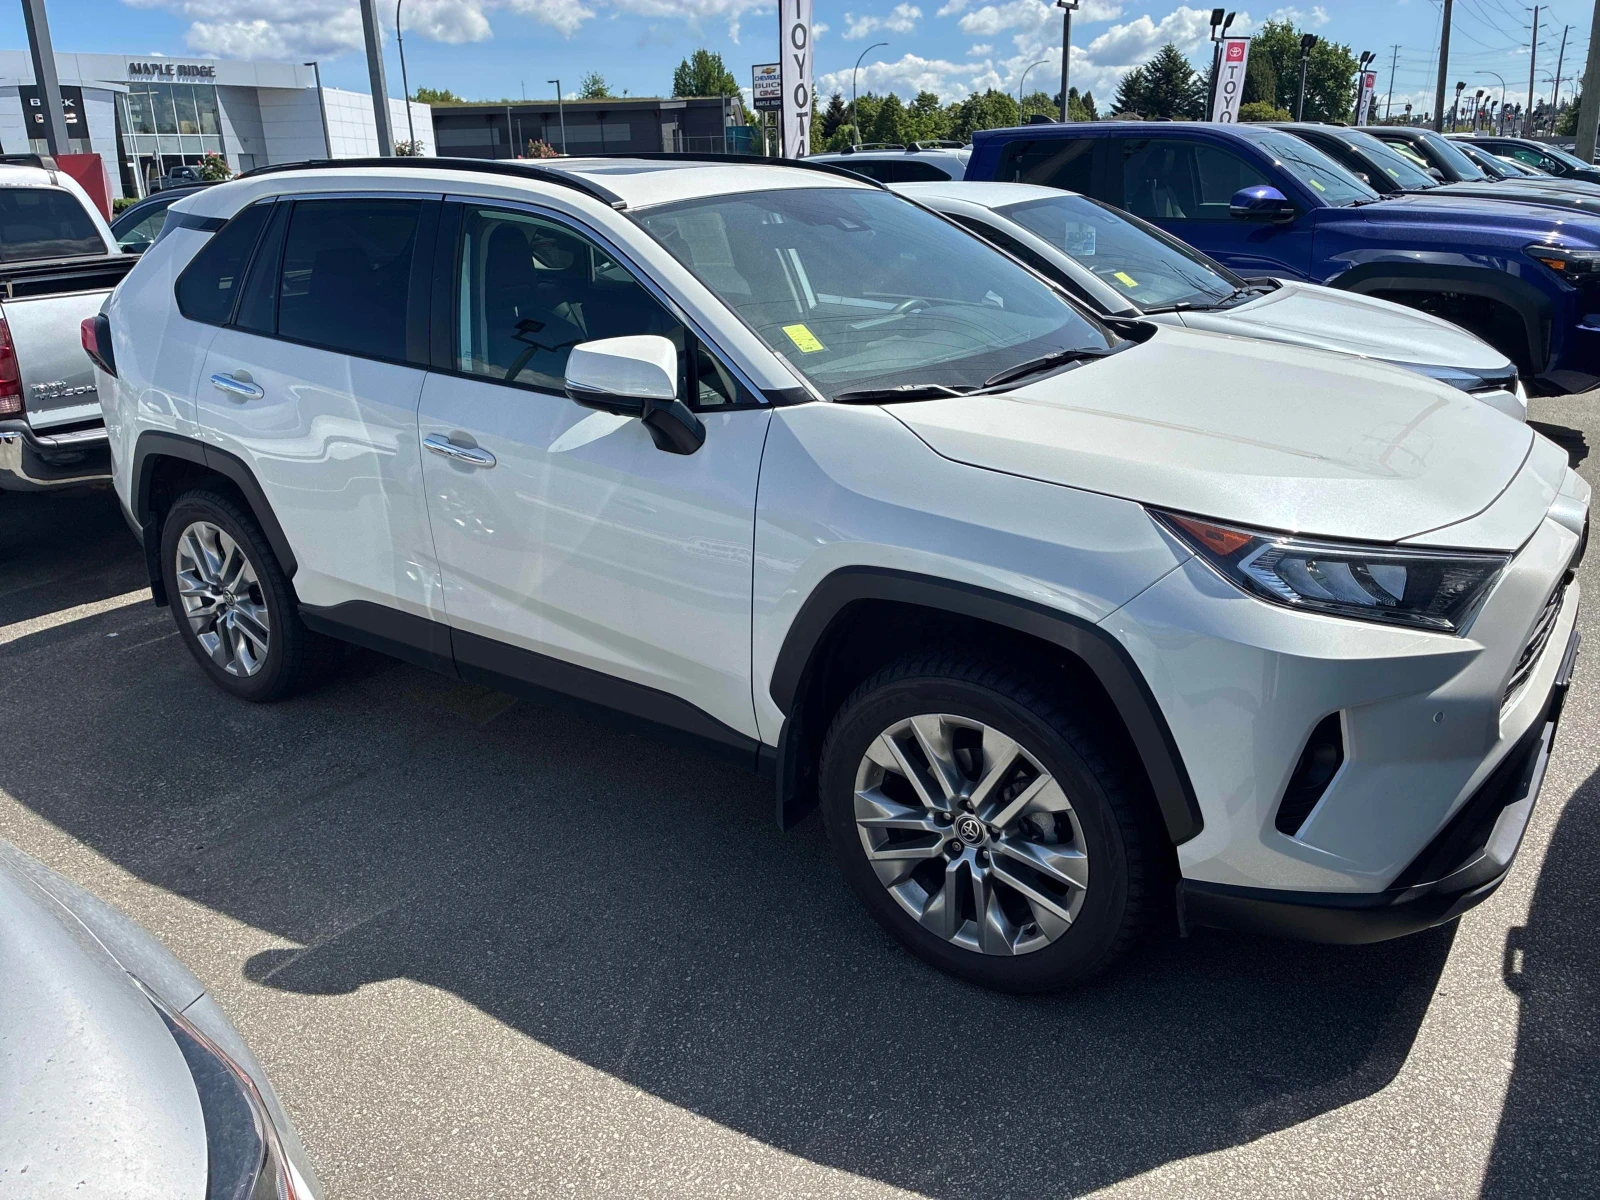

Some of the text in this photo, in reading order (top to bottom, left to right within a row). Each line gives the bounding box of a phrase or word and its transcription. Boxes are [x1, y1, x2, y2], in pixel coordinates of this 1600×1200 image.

[128, 62, 216, 78] MAPLE RIDGE
[755, 74, 781, 82] CHEVROLE
[759, 89, 780, 97] GMC
[1220, 66, 1238, 123] TOYO
